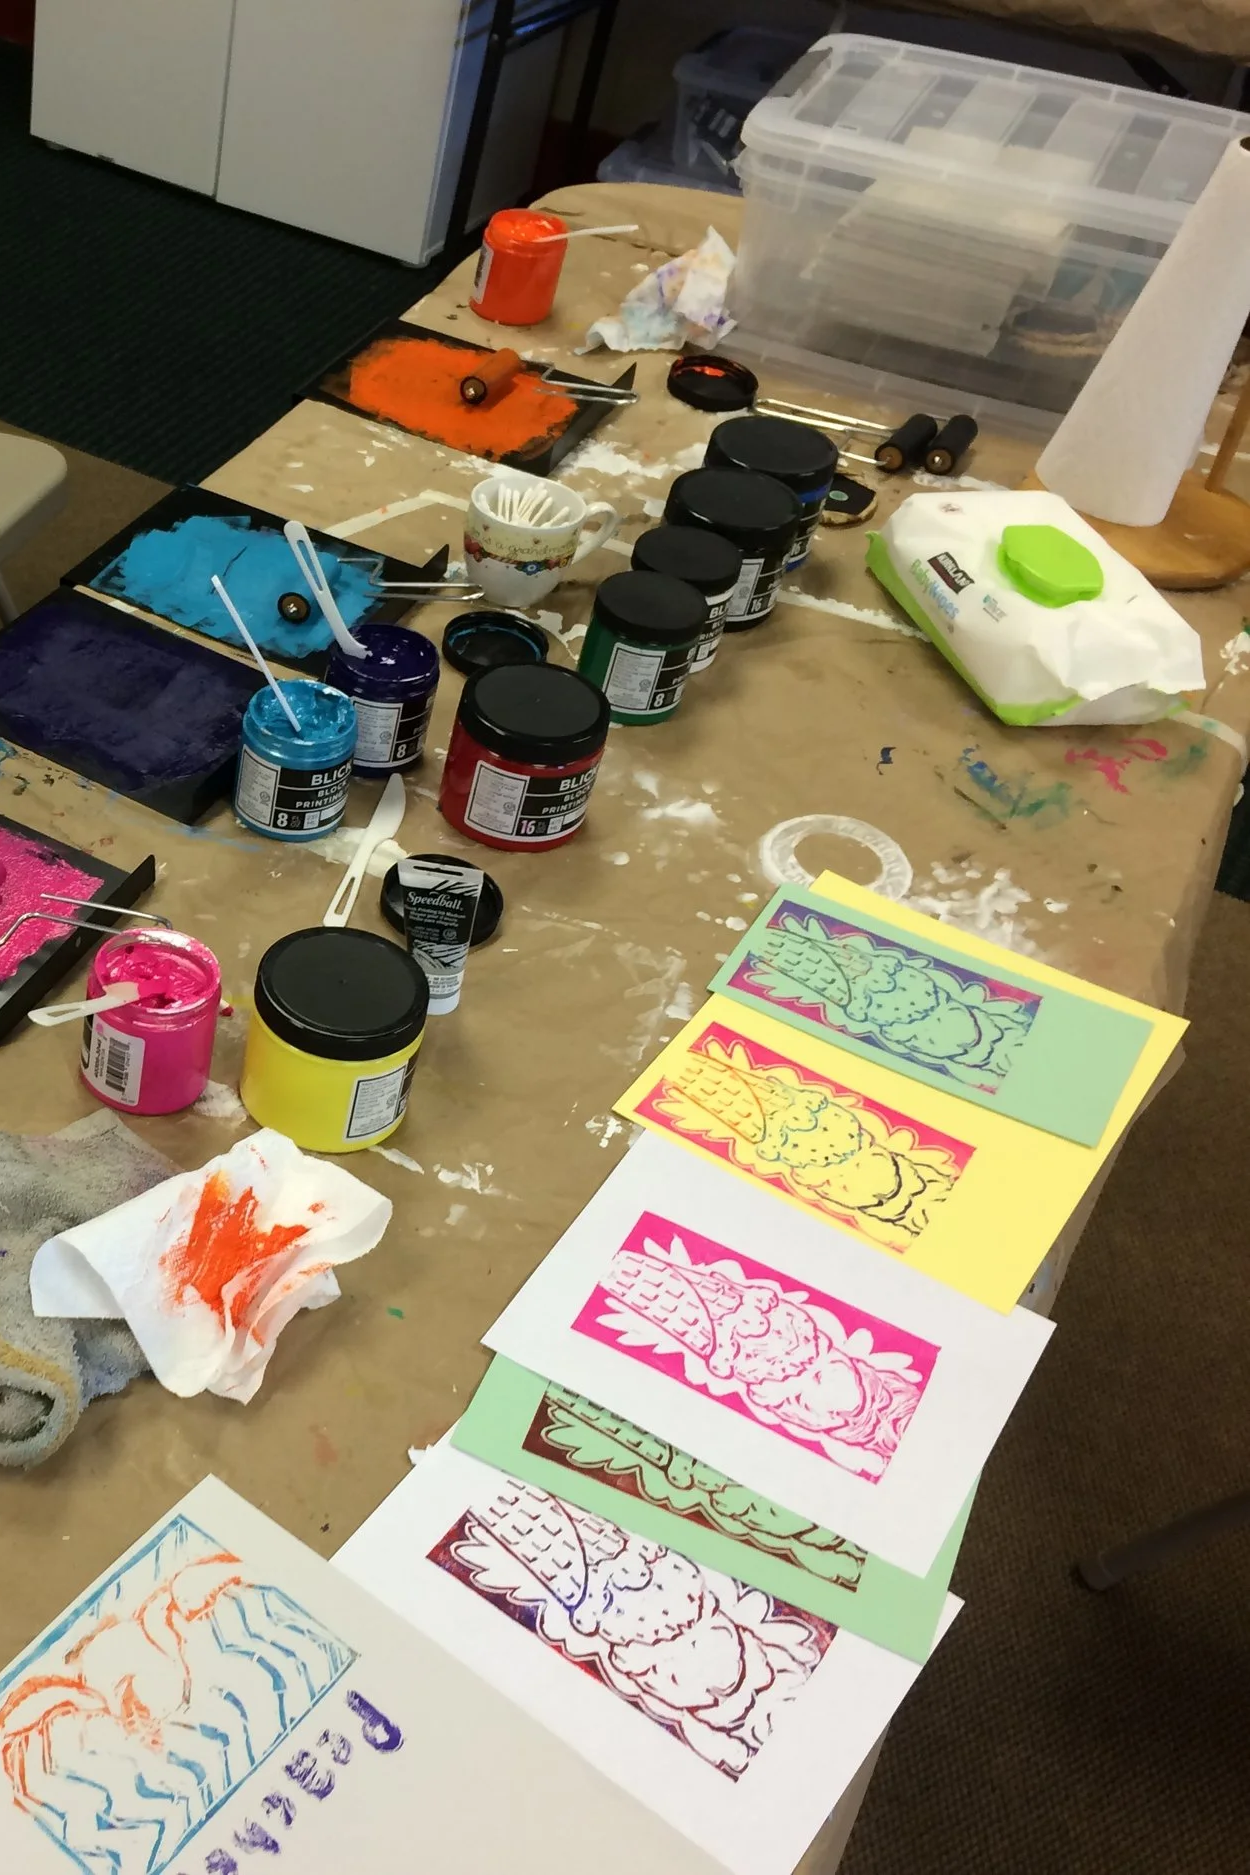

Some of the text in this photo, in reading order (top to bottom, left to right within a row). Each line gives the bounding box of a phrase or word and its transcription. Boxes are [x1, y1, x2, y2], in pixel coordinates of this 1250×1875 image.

[750, 598, 762, 613] 16
[653, 693, 664, 707] 8
[396, 744, 407, 758] 8
[311, 761, 352, 787] BLICK
[276, 812, 289, 828] 8
[520, 819, 537, 835] 16
[406, 891, 461, 910] Speedball
